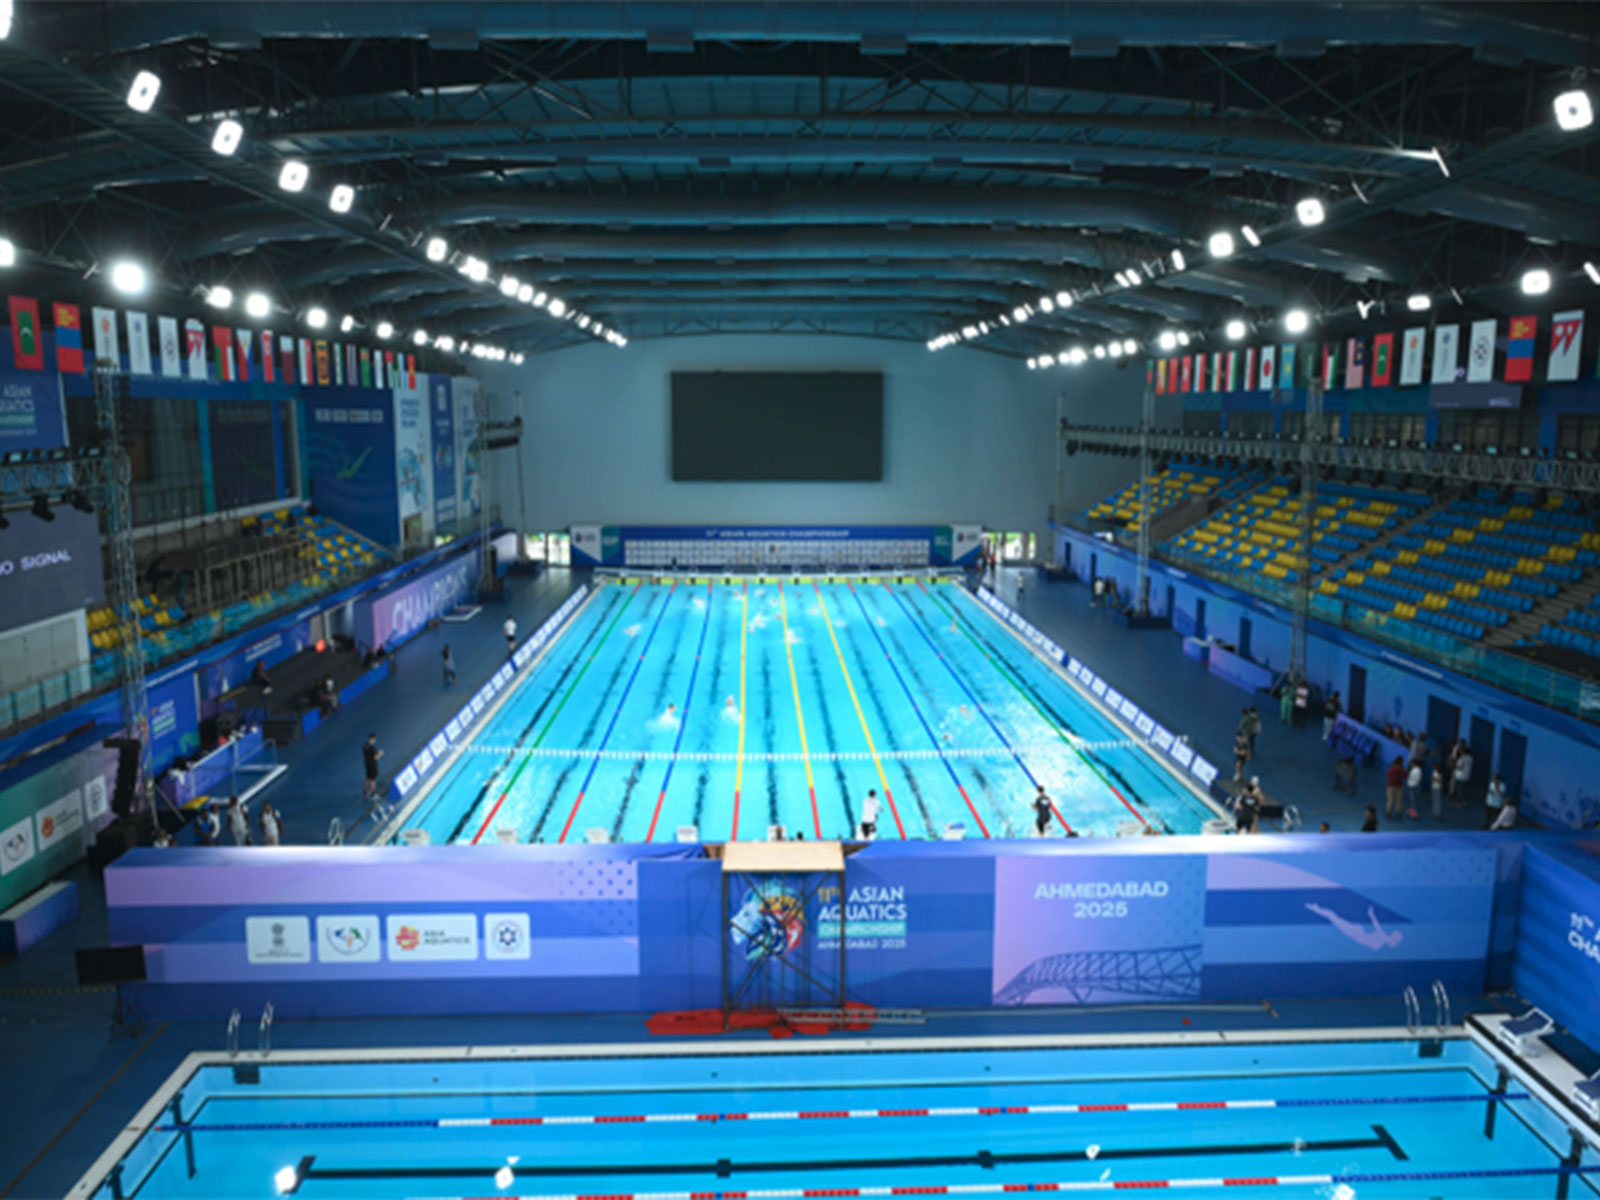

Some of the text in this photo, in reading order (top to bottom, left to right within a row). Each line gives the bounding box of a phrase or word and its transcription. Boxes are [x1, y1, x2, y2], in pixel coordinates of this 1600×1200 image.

[21, 549, 72, 571] SIGNAL
[848, 885, 905, 902] ASIAN
[1034, 881, 1169, 899] AHMEDABAD
[1073, 901, 1128, 918] 2025
[424, 929, 445, 937] ASIA
[424, 936, 470, 946] AQUATICS
